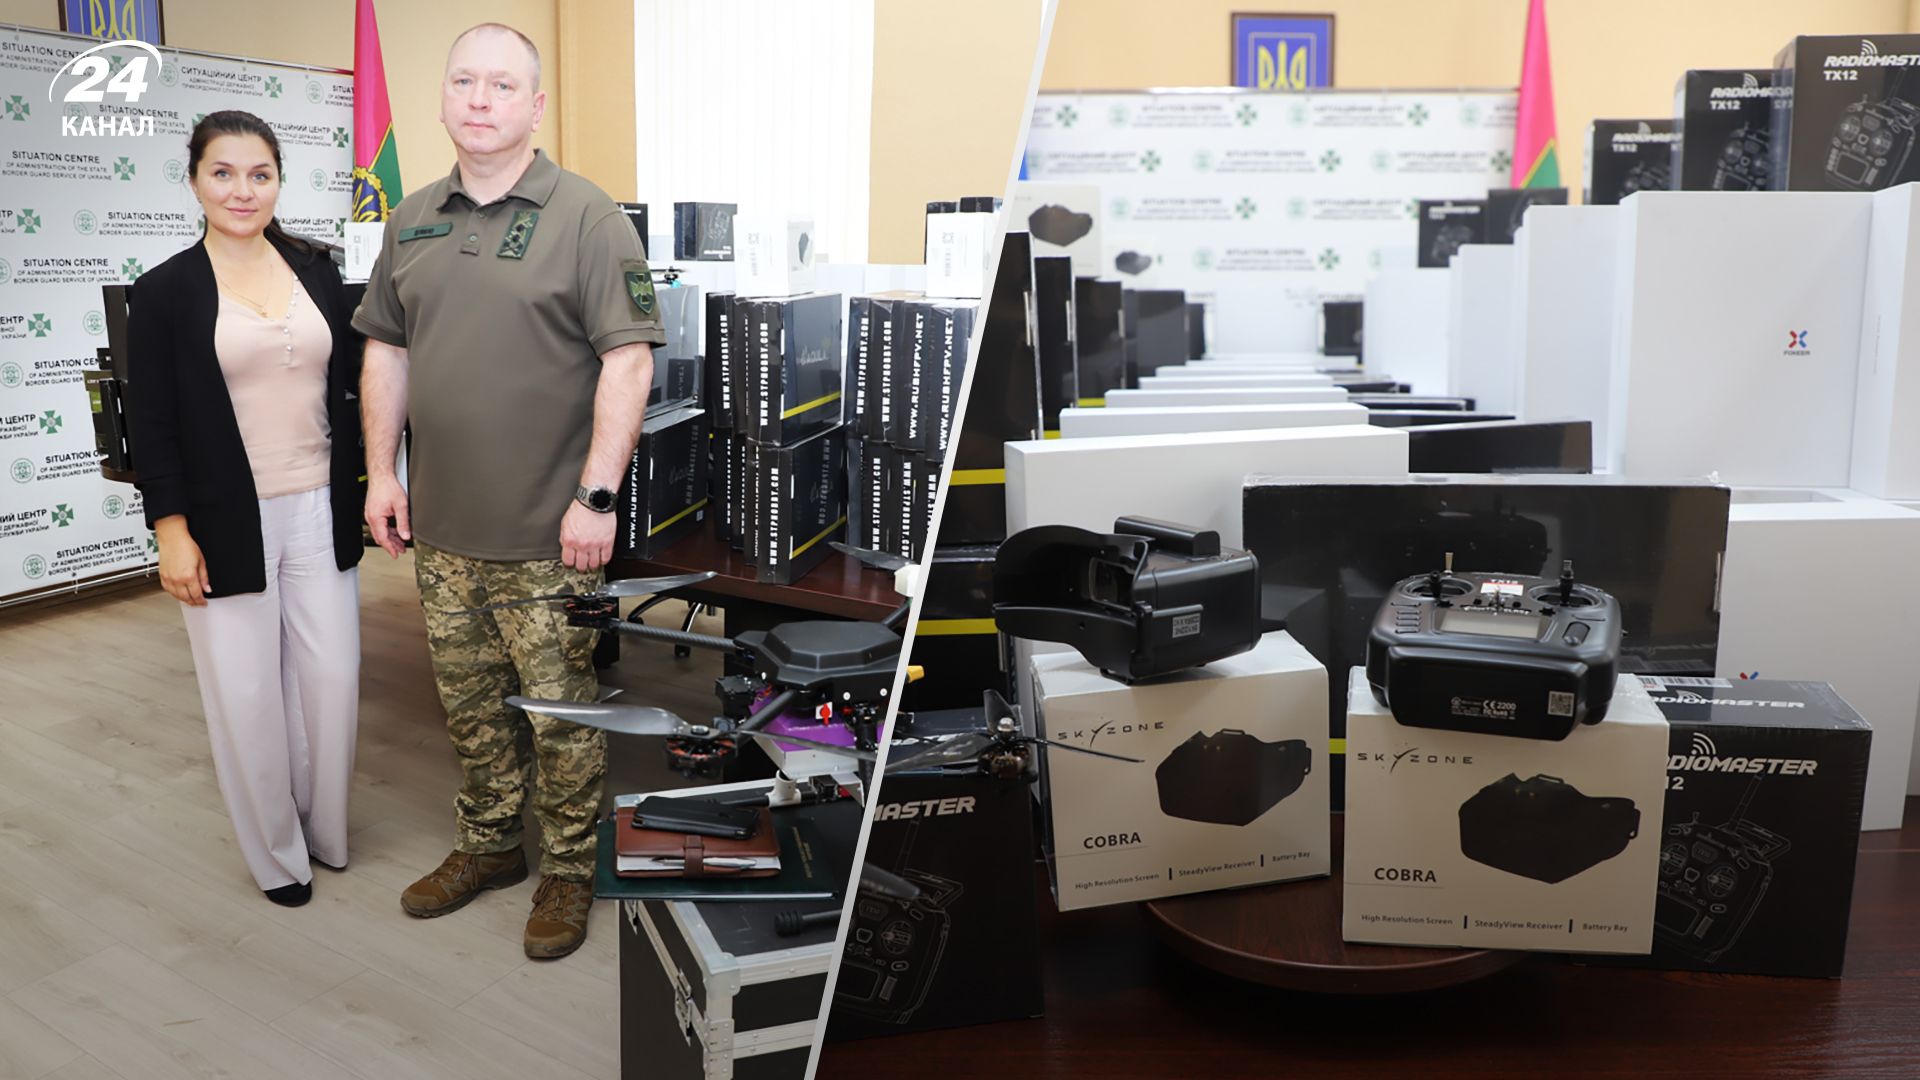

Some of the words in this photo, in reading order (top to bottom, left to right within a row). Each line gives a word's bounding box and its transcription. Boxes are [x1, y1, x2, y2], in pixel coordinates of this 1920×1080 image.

[2, 42, 53, 56] SITUATION
[1824, 54, 1920, 67] RADIOMAST
[238, 73, 262, 82] ЦЕНТР
[1823, 70, 1858, 80] TX12
[99, 104, 144, 116] SITUATION
[146, 109, 179, 119] CENTRE
[1710, 100, 1741, 110] TX12
[12, 151, 62, 161] SITUATION
[64, 154, 100, 164] CENTRE
[108, 211, 152, 220] SITUATION
[154, 213, 185, 221] CENTRE
[23, 258, 71, 267] SITUATION
[74, 258, 109, 267] CENTRE
[0, 316, 24, 325] ЕНТР
[34, 358, 81, 369] SITUATION
[856, 317, 869, 414] WWW.STPHOBBY.COM
[760, 322, 769, 426] WWW.STPHOBBY.COM
[881, 320, 892, 422] WWW.STPHOBBY.COM
[5, 414, 36, 425] ЦЕНТР
[45, 451, 91, 464] SITUATION
[16, 508, 47, 521] ЦЕНТР
[769, 467, 779, 565] WWW.STPHOBBY.COM
[56, 543, 101, 559] SITUATION
[101, 536, 135, 550] CENTRE
[1497, 702, 1517, 710] 2200
[1058, 720, 1164, 748] SKYZONE
[1357, 748, 1473, 773] SKYZONE
[1667, 754, 1818, 776] DIOMASTER
[1083, 832, 1142, 849] COBRA
[1075, 881, 1093, 890] High
[1094, 877, 1134, 888] Resolution
[1135, 873, 1160, 882] Screen
[1179, 865, 1222, 877] SteadyView
[1224, 860, 1256, 870] Receiver
[1272, 853, 1297, 863] Battery
[1298, 851, 1311, 861] Bay
[1374, 867, 1437, 883] COBRA
[1361, 914, 1381, 924] High
[1382, 915, 1425, 925] Resolution
[1426, 916, 1453, 926] Screen
[1475, 919, 1524, 930] SteadyView
[1526, 921, 1563, 931] Receiver
[1582, 923, 1612, 933] Battery
[1614, 924, 1628, 933] Bay
